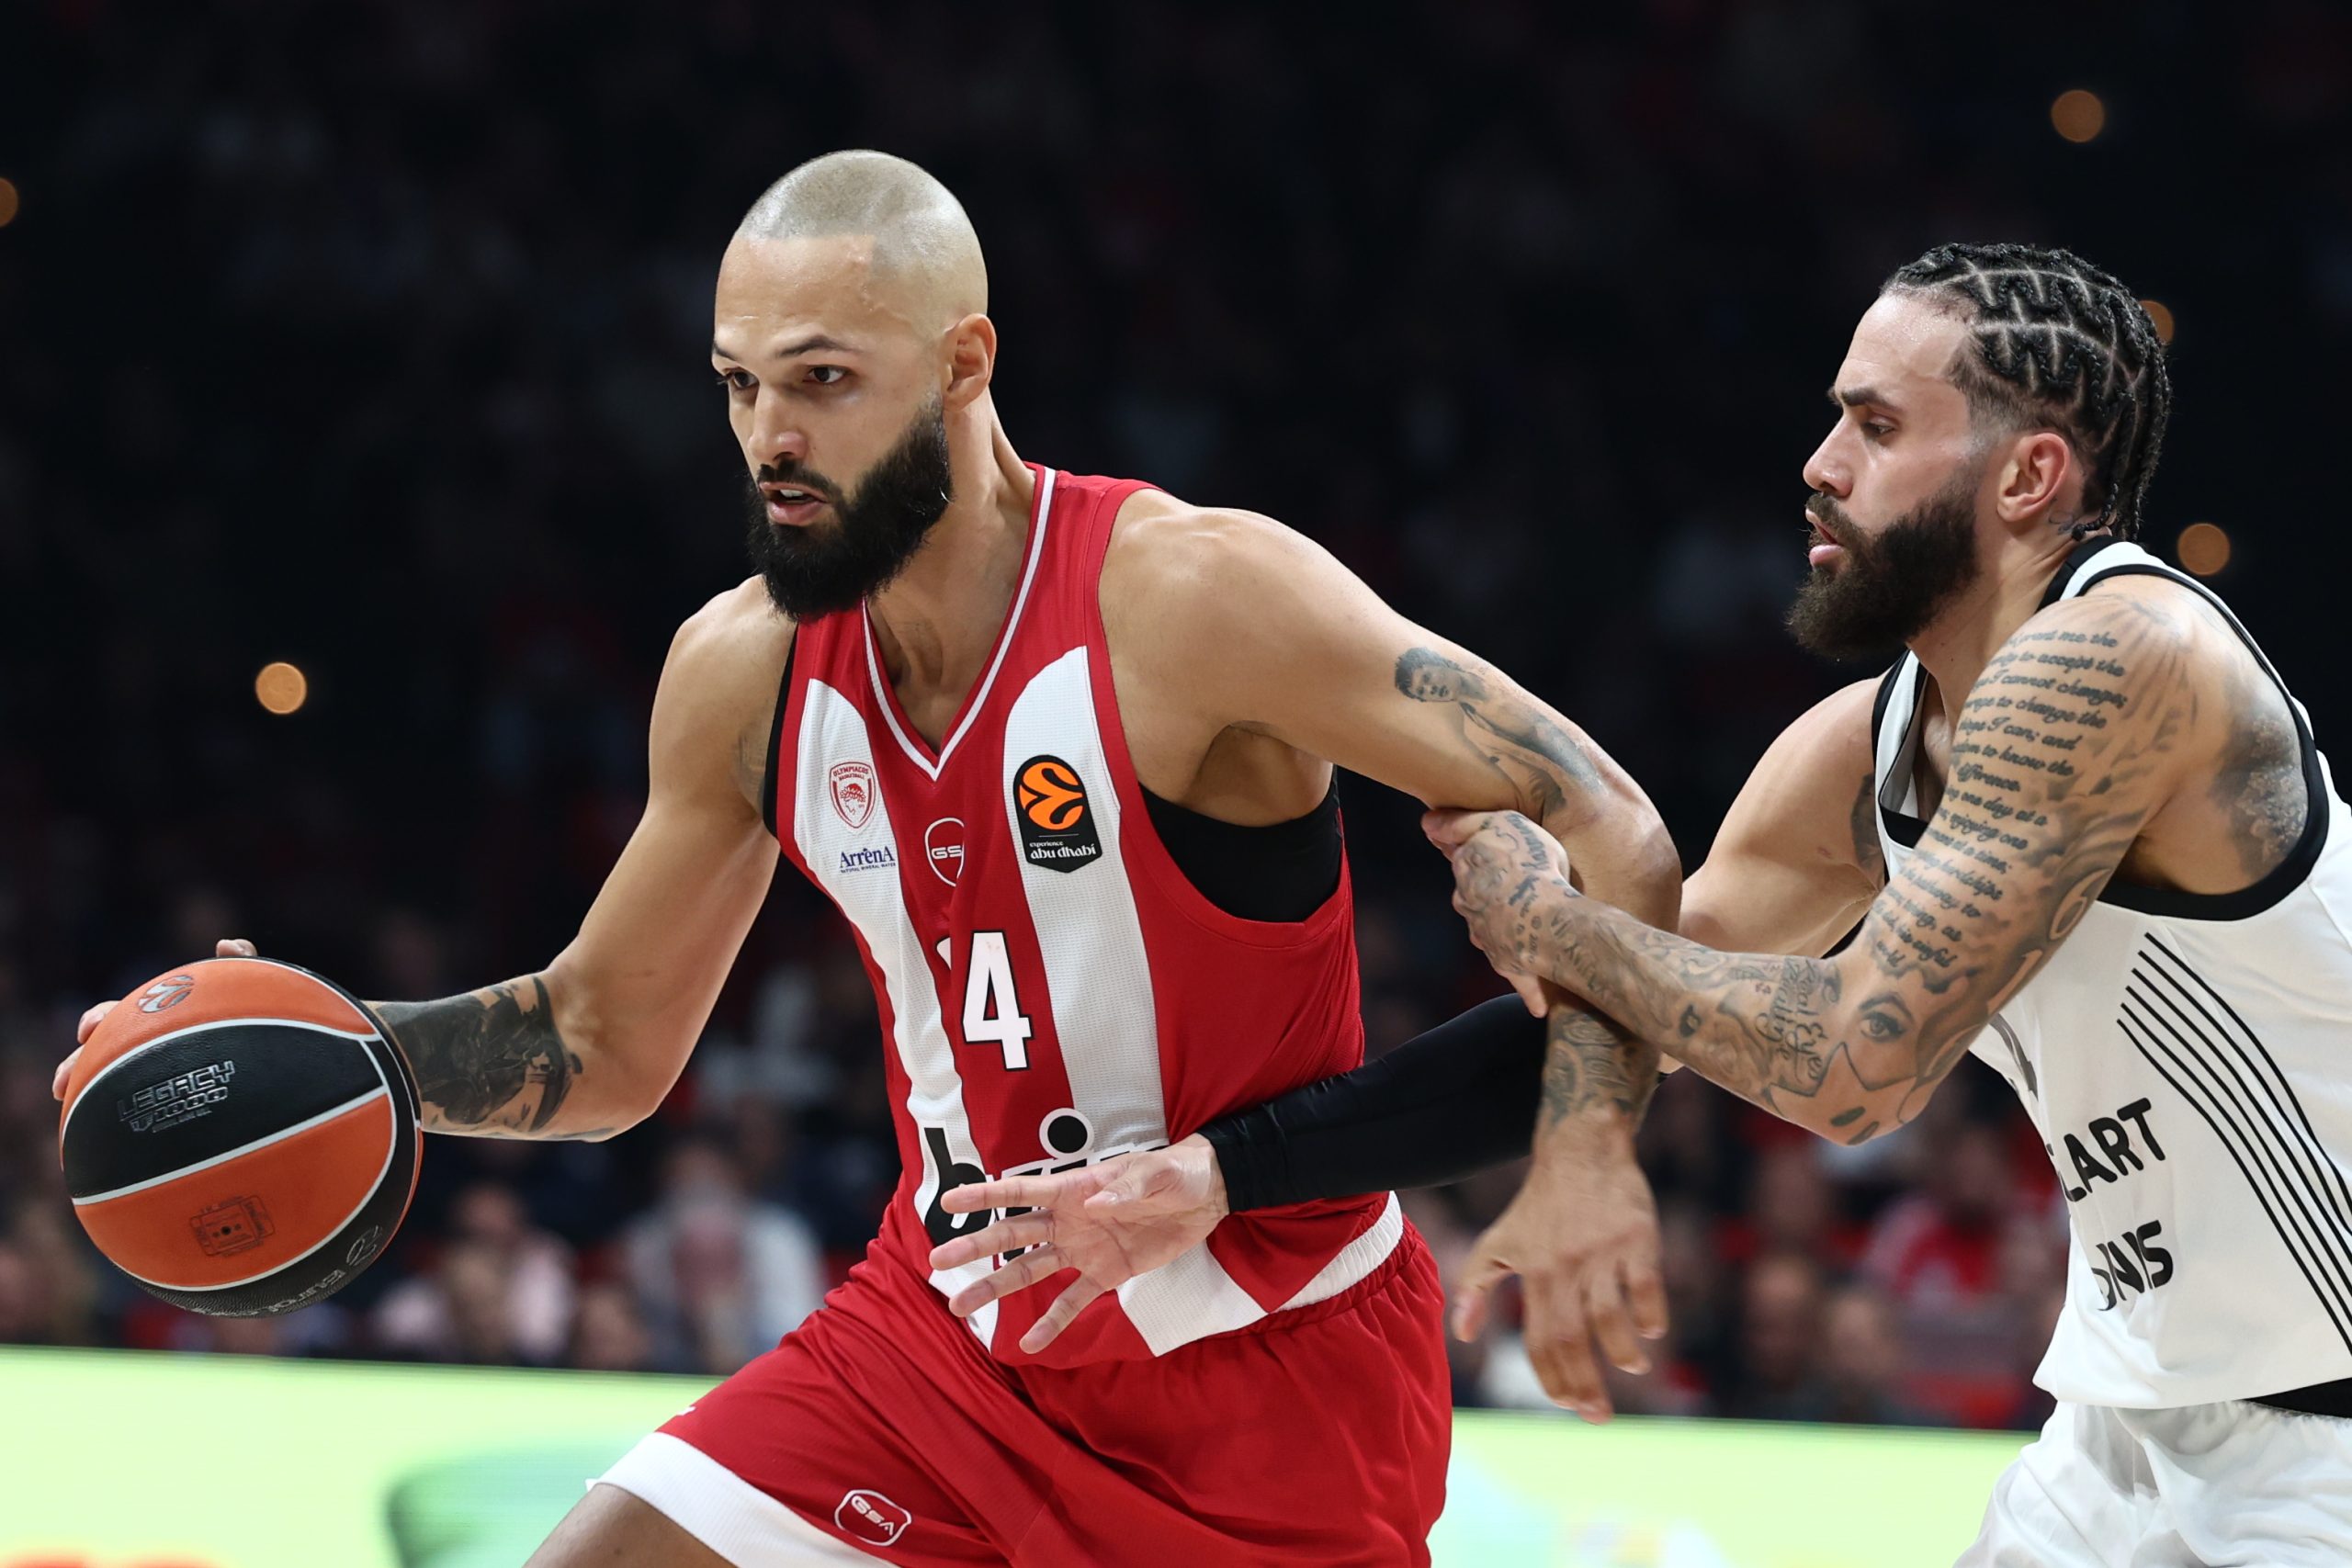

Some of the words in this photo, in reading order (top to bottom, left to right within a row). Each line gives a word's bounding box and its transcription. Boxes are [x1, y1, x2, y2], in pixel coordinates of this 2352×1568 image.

[1030, 848, 1056, 859] abu
[1057, 843, 1096, 858] dhabi
[118, 1060, 235, 1122] LEGACY
[851, 1495, 895, 1536] GSA
